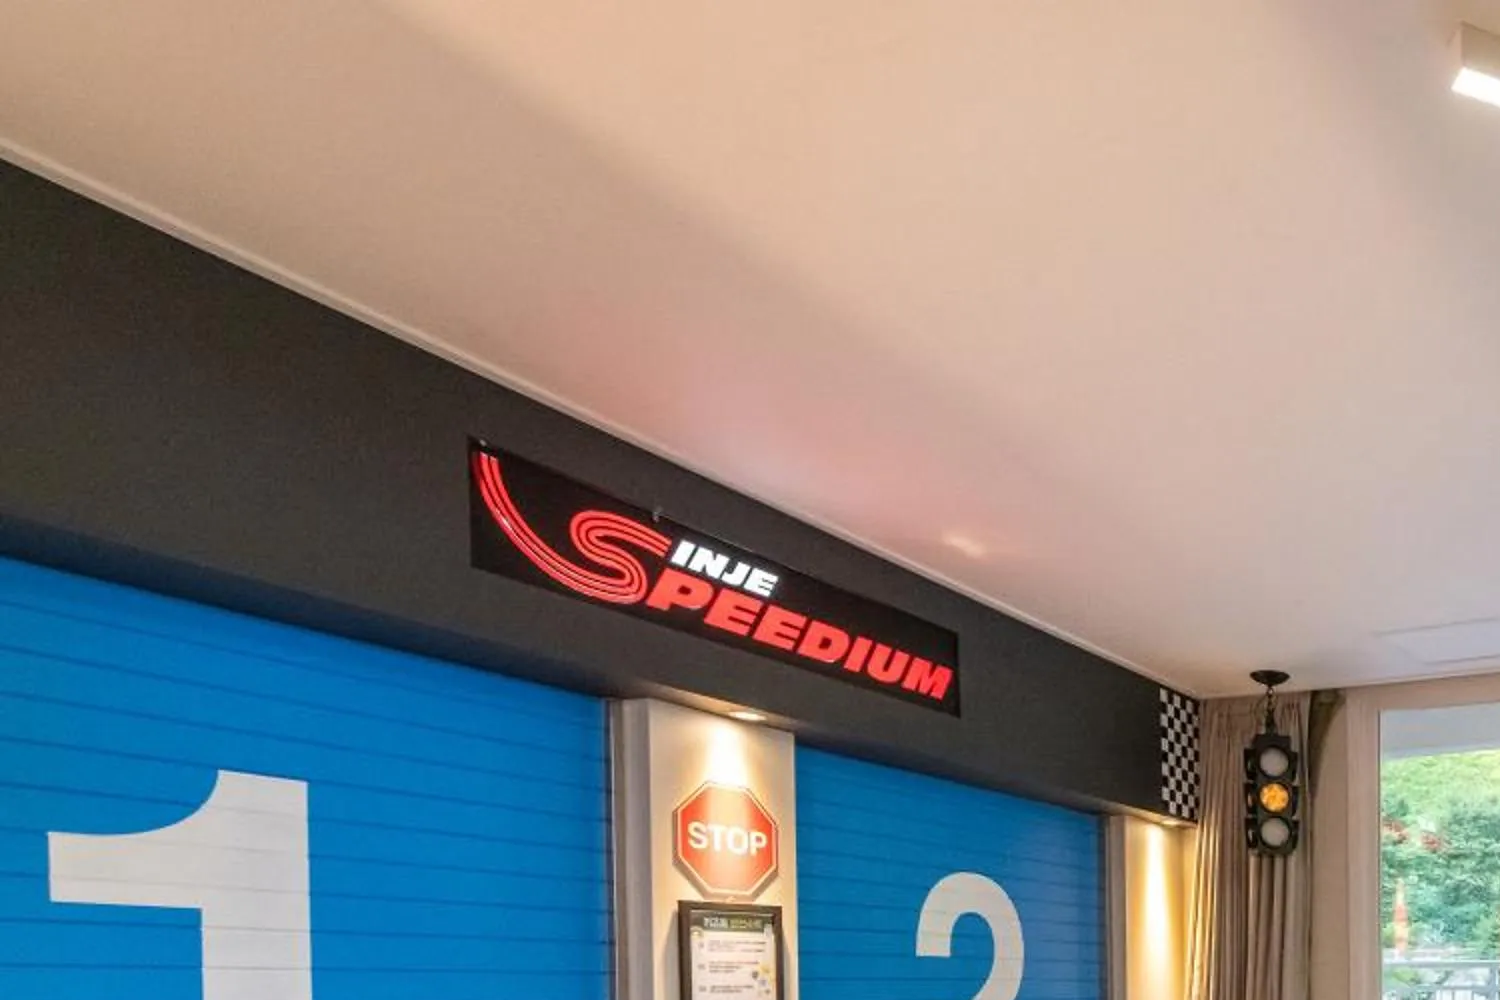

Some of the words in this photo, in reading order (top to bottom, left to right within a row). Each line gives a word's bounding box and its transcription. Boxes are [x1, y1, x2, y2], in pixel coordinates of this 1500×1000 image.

[474, 451, 954, 700] SPEEDIUM
[670, 538, 778, 597] INJE
[687, 821, 768, 857] STOP
